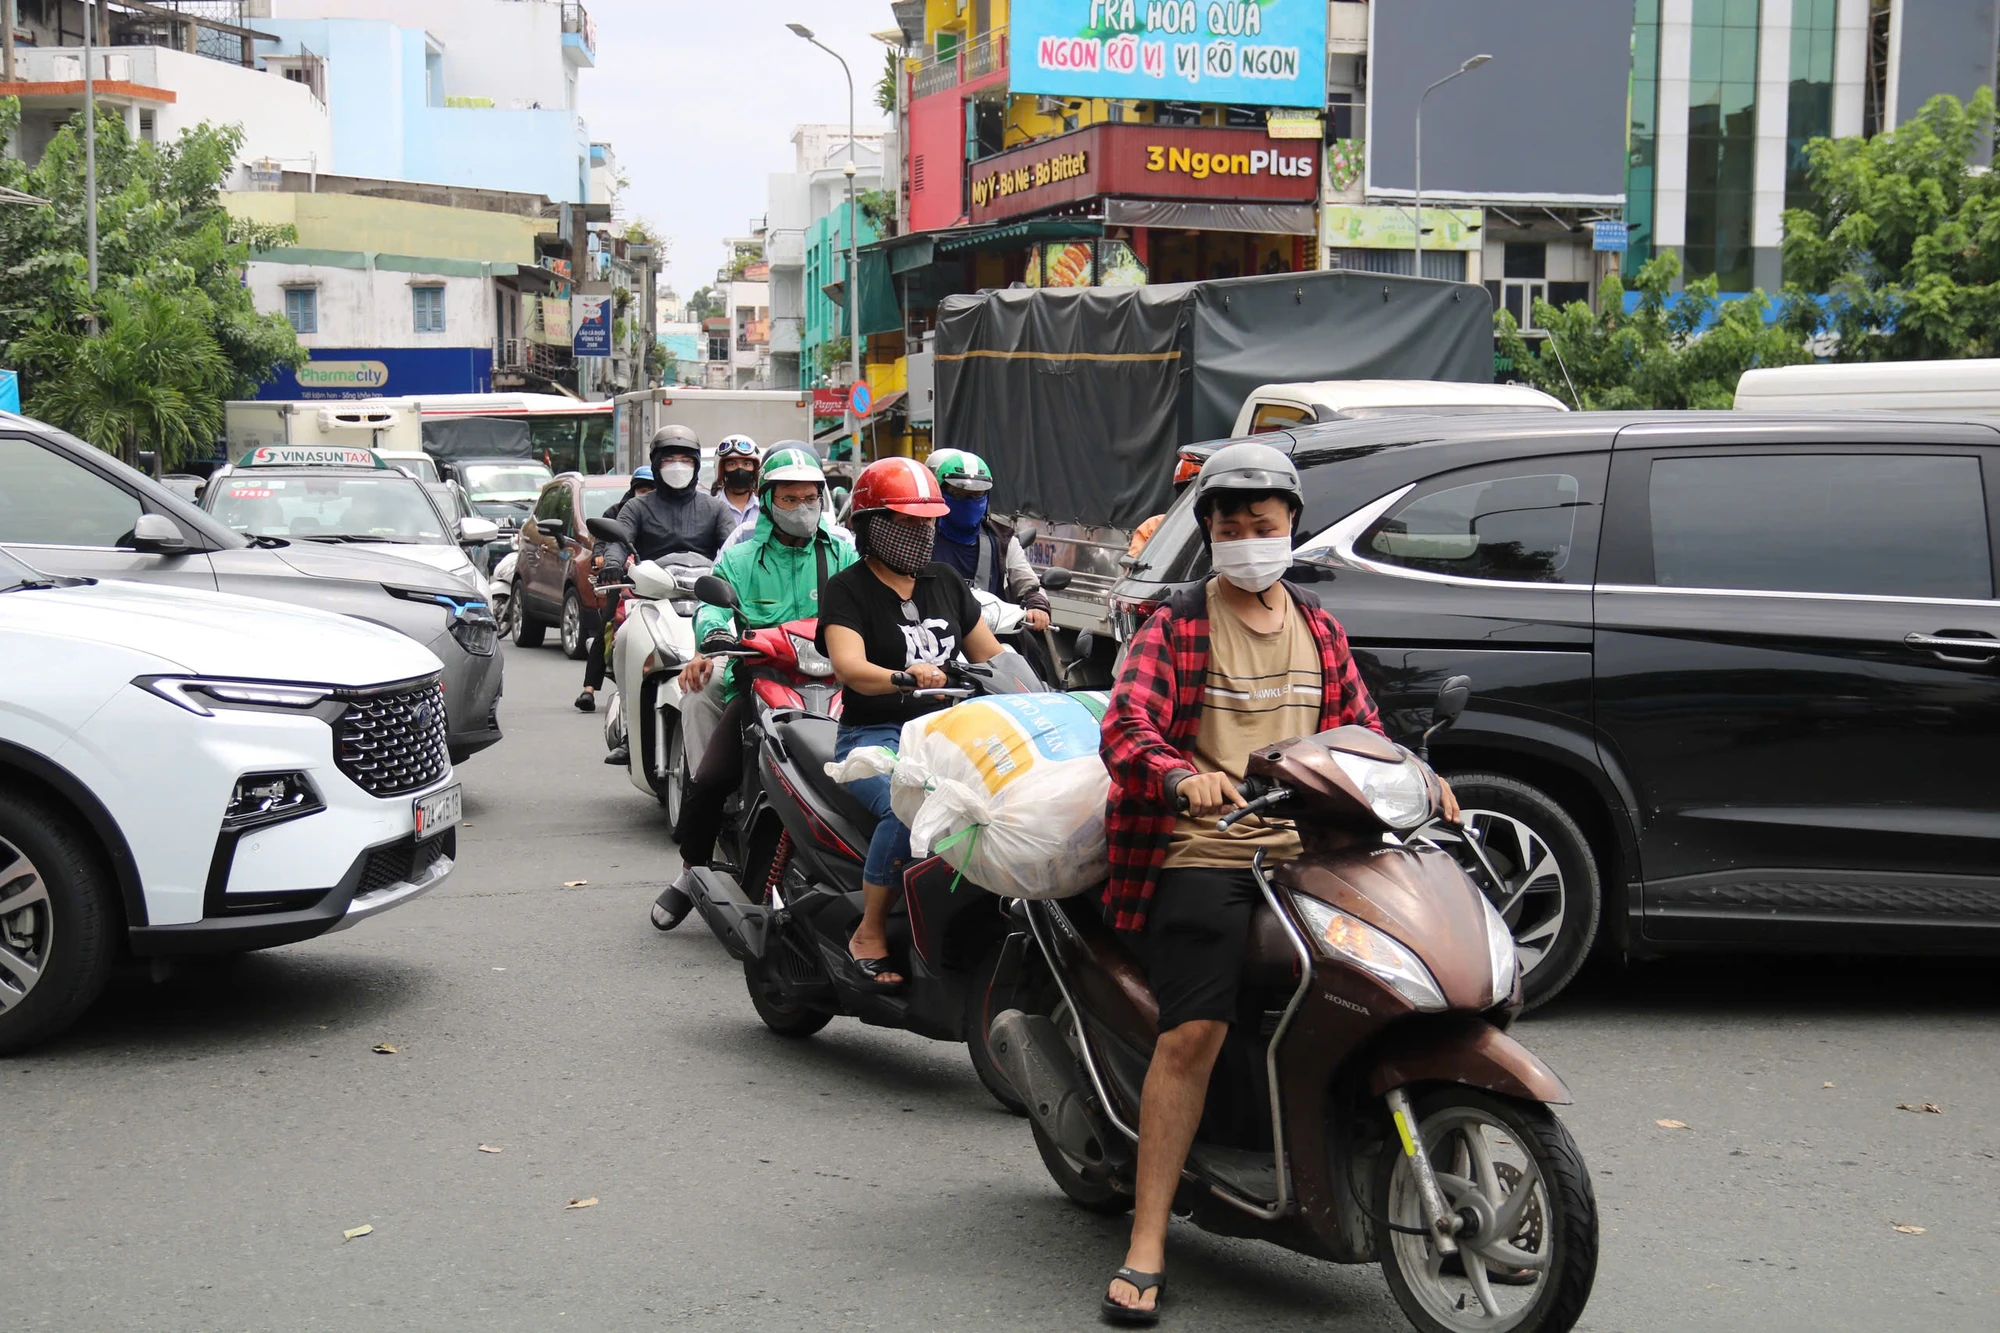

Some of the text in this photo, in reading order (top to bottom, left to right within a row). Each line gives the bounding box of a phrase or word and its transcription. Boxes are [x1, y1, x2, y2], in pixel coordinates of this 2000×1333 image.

[1146, 0, 1197, 35] HOA
[1041, 37, 1296, 79] NGON RÕ VỊ VỊ RÕ NGON
[1000, 171, 1014, 196] Bò
[1015, 165, 1030, 192] Né
[1035, 159, 1051, 186] Bò
[1051, 151, 1086, 182] Bittet
[1146, 146, 1165, 172] 3
[301, 365, 382, 385] Pharmacity
[1324, 992, 1371, 1016] HONDA
